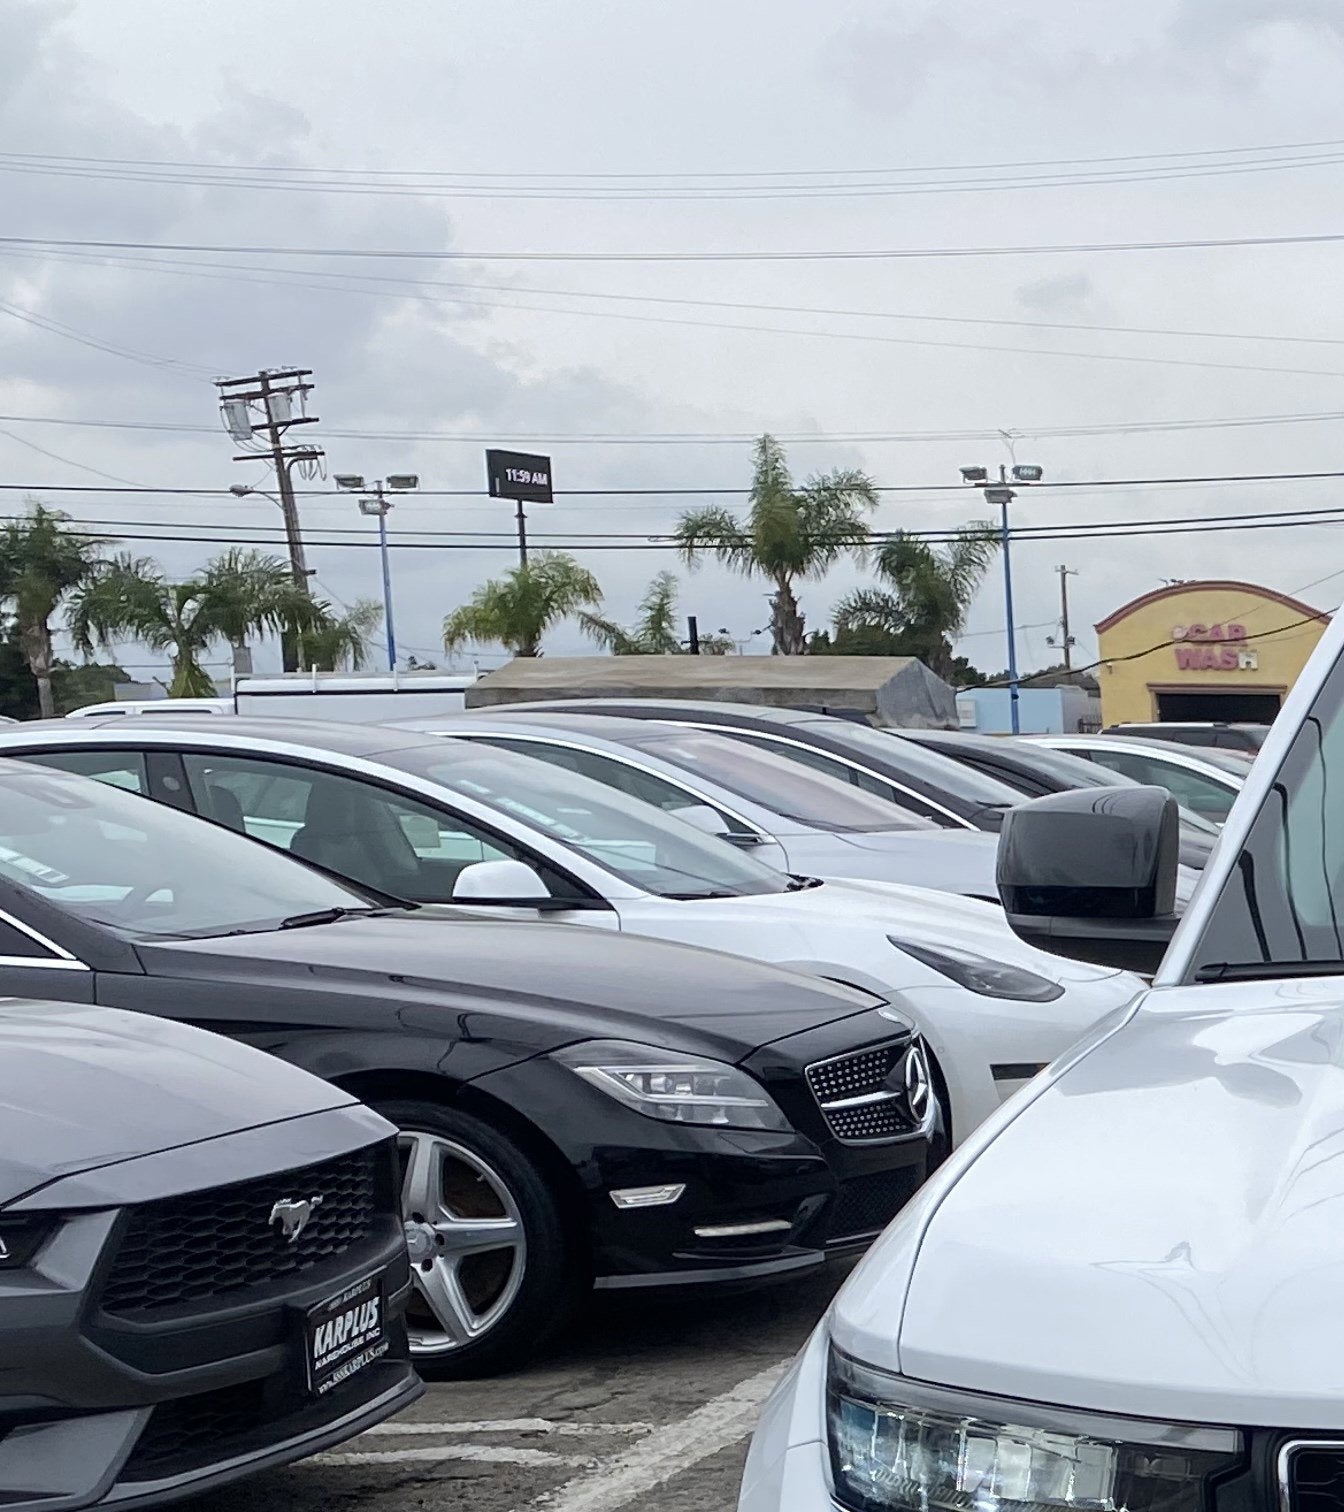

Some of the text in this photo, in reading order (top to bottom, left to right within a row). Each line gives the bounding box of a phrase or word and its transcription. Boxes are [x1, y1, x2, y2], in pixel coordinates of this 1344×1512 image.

[505, 468, 548, 485] 11:59 AM
[1187, 623, 1249, 647] CAR
[1174, 648, 1259, 671] WASH
[313, 1296, 380, 1359] KARPLUS
